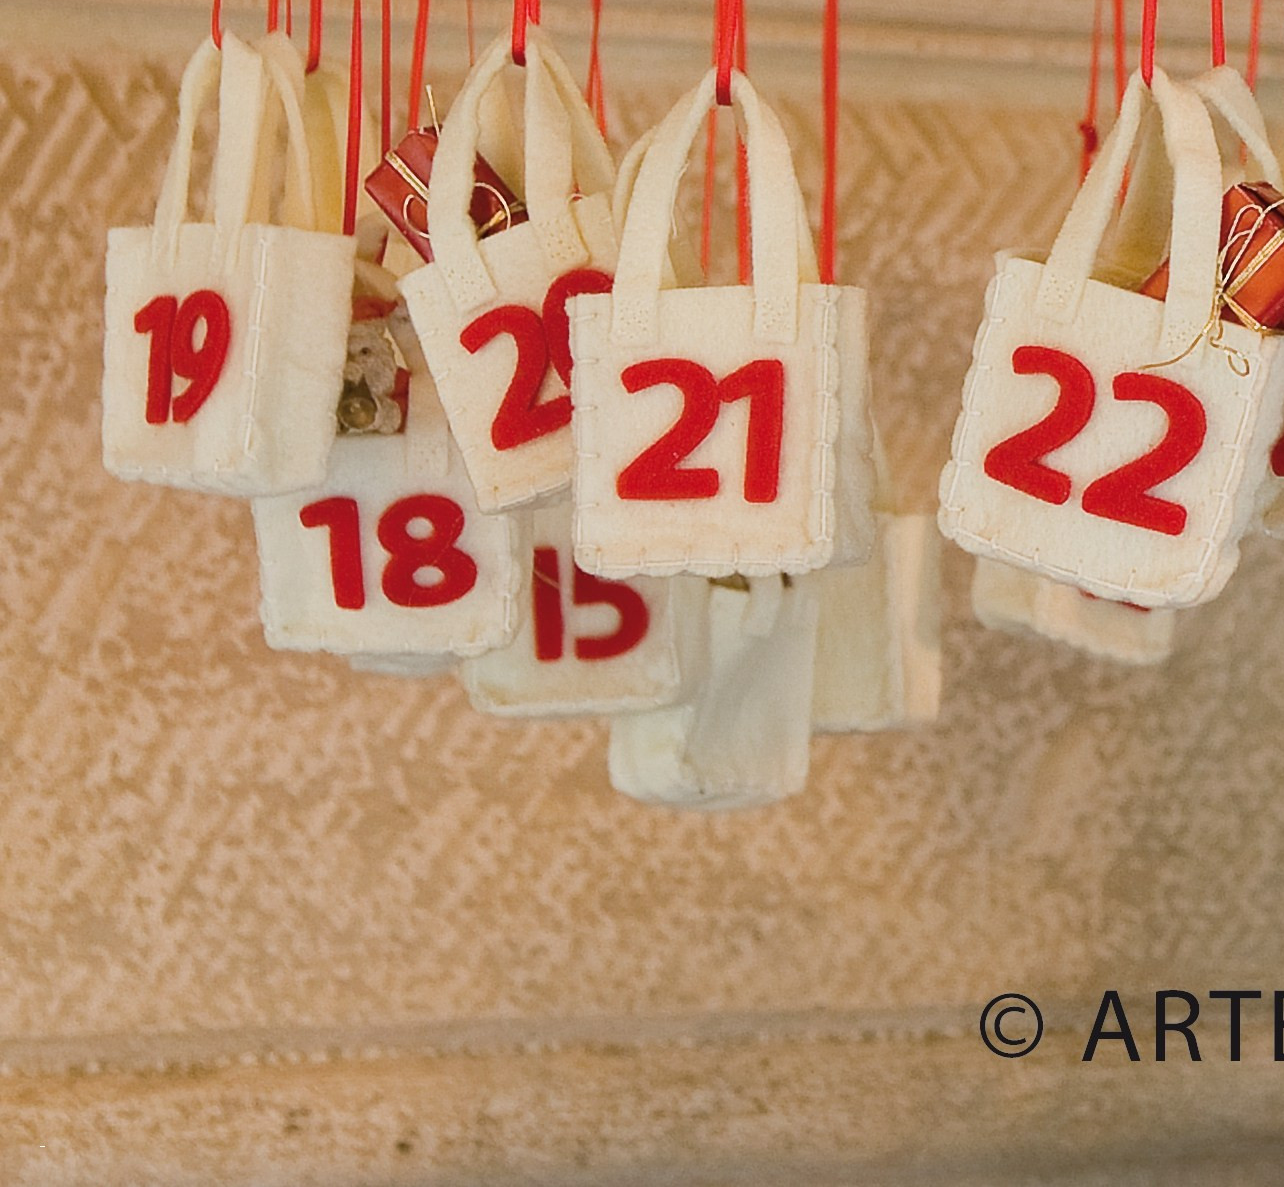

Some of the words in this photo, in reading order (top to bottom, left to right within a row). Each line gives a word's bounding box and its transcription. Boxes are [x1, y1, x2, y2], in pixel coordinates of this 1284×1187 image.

[133, 288, 233, 426] 19
[616, 357, 787, 505] 21
[983, 344, 1208, 537] 22
[299, 493, 479, 612] 18
[532, 546, 652, 663] 15
